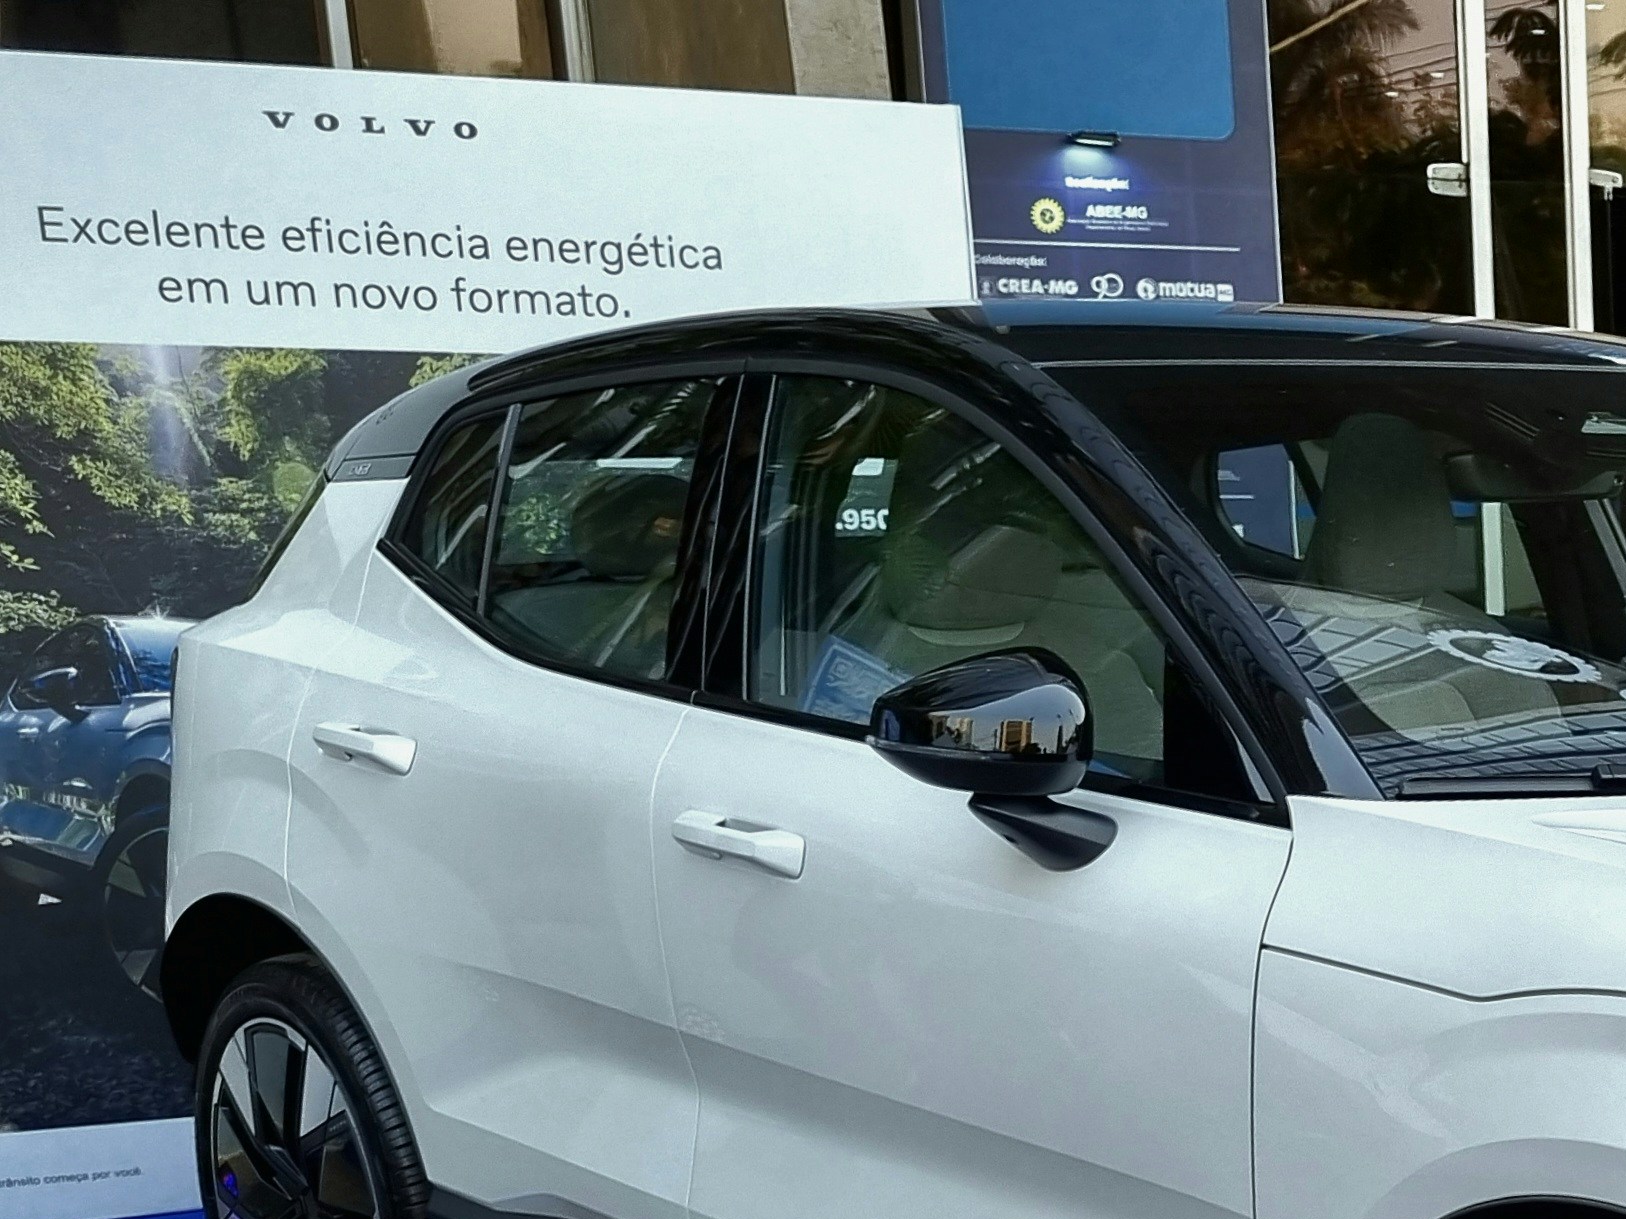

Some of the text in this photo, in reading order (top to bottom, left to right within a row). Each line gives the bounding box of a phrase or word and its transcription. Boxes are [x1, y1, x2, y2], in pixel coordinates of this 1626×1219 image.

[261, 110, 479, 140] VOLVO
[37, 205, 724, 276] Excelente eficiência energética
[158, 275, 631, 319] em um novo formato.
